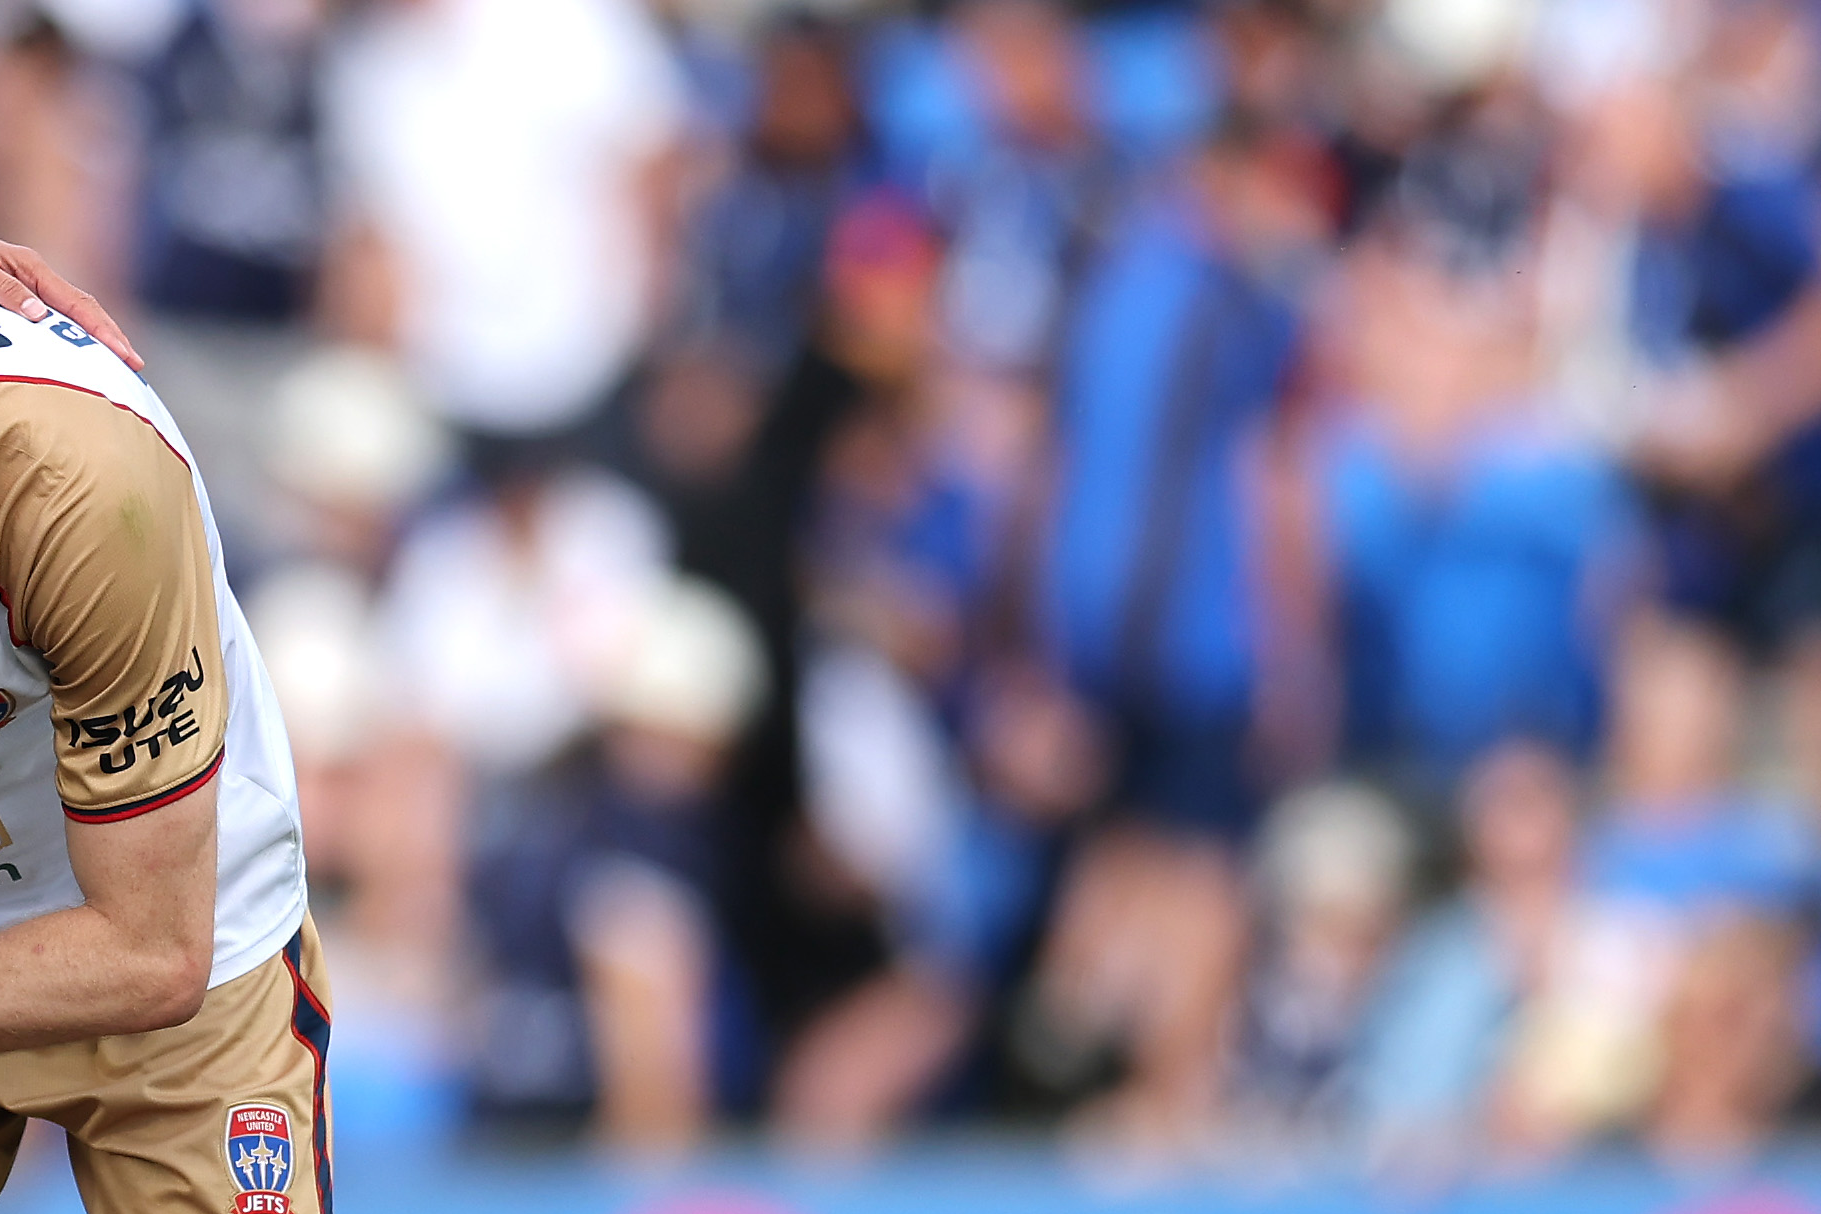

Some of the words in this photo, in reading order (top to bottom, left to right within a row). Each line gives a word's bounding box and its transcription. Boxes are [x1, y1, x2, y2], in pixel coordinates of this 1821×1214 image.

[64, 646, 204, 748] ISUZU
[100, 709, 200, 774] UTE
[237, 1110, 284, 1125] NEWCASTLE
[246, 1121, 275, 1132] UNITED
[243, 1194, 285, 1214] JETS
